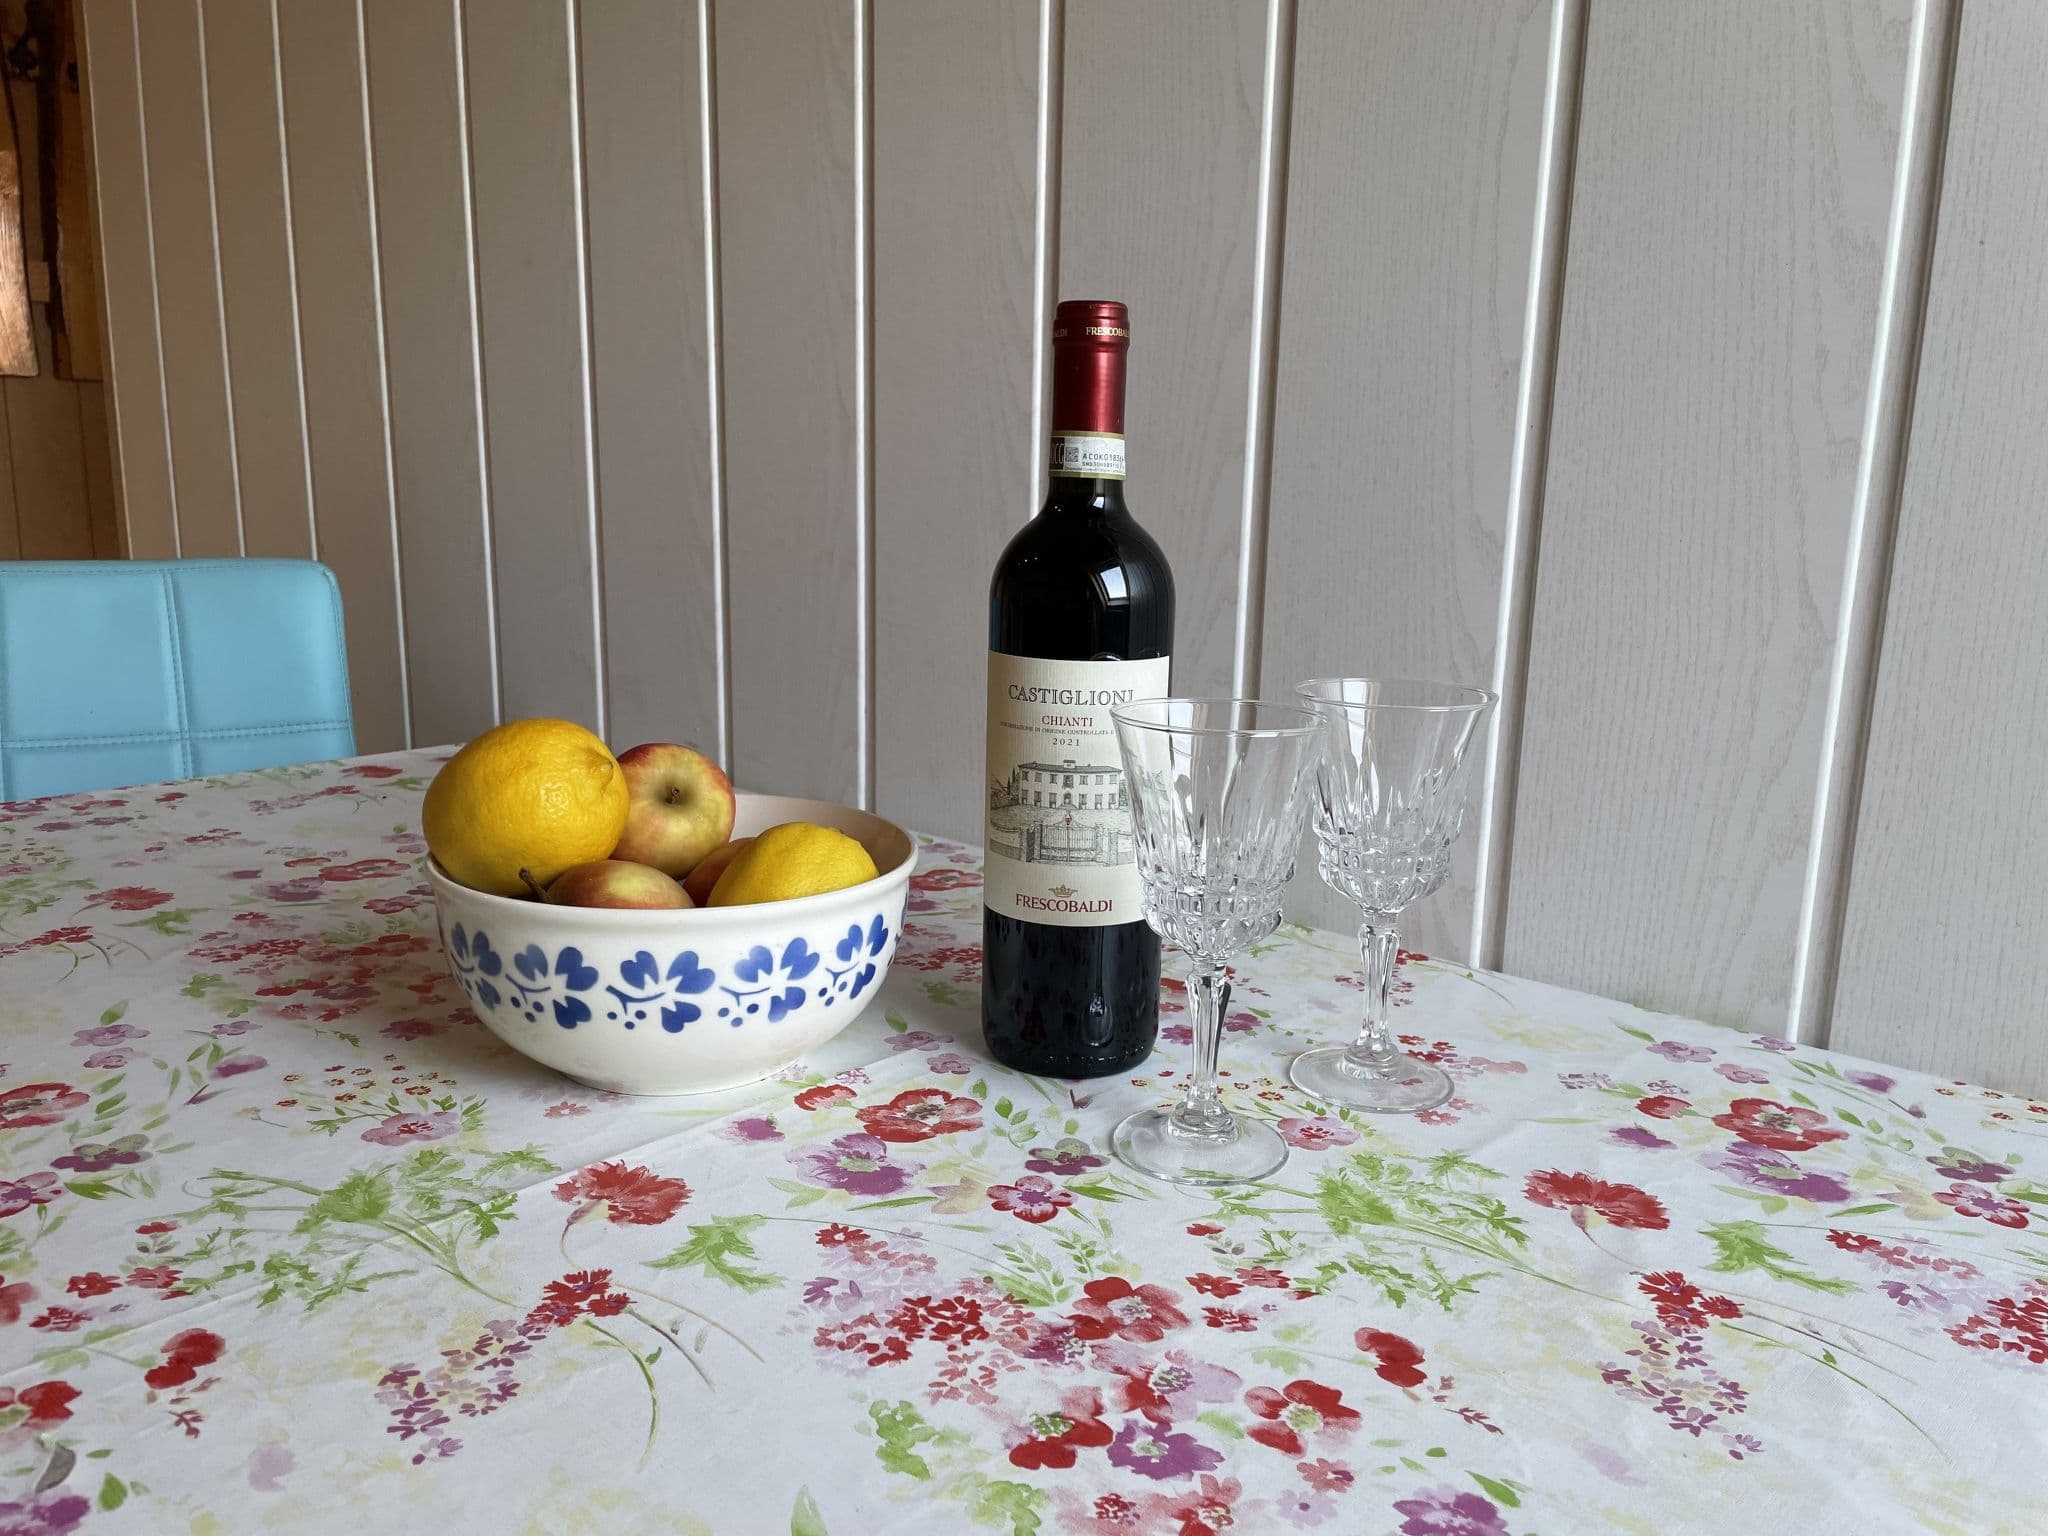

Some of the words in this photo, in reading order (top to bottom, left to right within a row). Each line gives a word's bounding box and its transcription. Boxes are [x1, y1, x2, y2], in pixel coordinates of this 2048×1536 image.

[1008, 684, 1134, 706] CASTIGLIONI
[1041, 715, 1093, 727] CHIANTI
[1052, 737, 1080, 747] 2021
[1015, 893, 1113, 913] FRESCOBALDI
